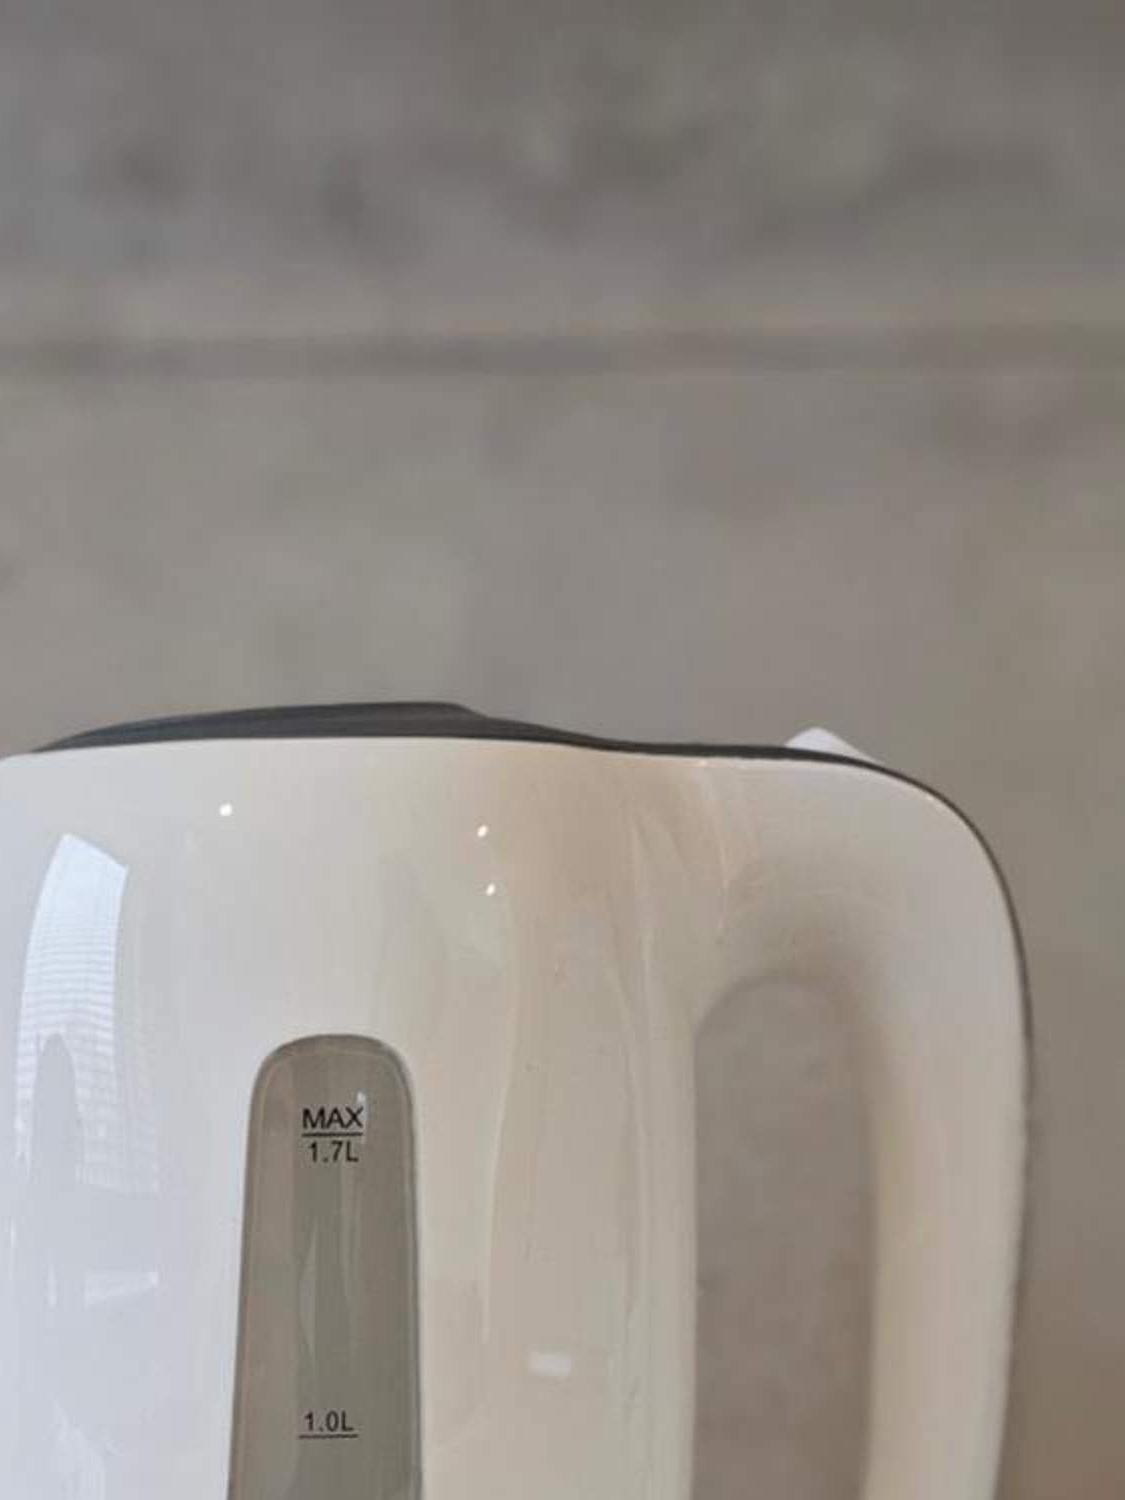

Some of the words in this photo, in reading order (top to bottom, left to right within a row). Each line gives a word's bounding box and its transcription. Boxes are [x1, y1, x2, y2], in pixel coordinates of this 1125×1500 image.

[301, 1106, 364, 1130] MAX
[307, 1140, 359, 1163] 1.7L
[303, 1410, 355, 1432] 1.0L
